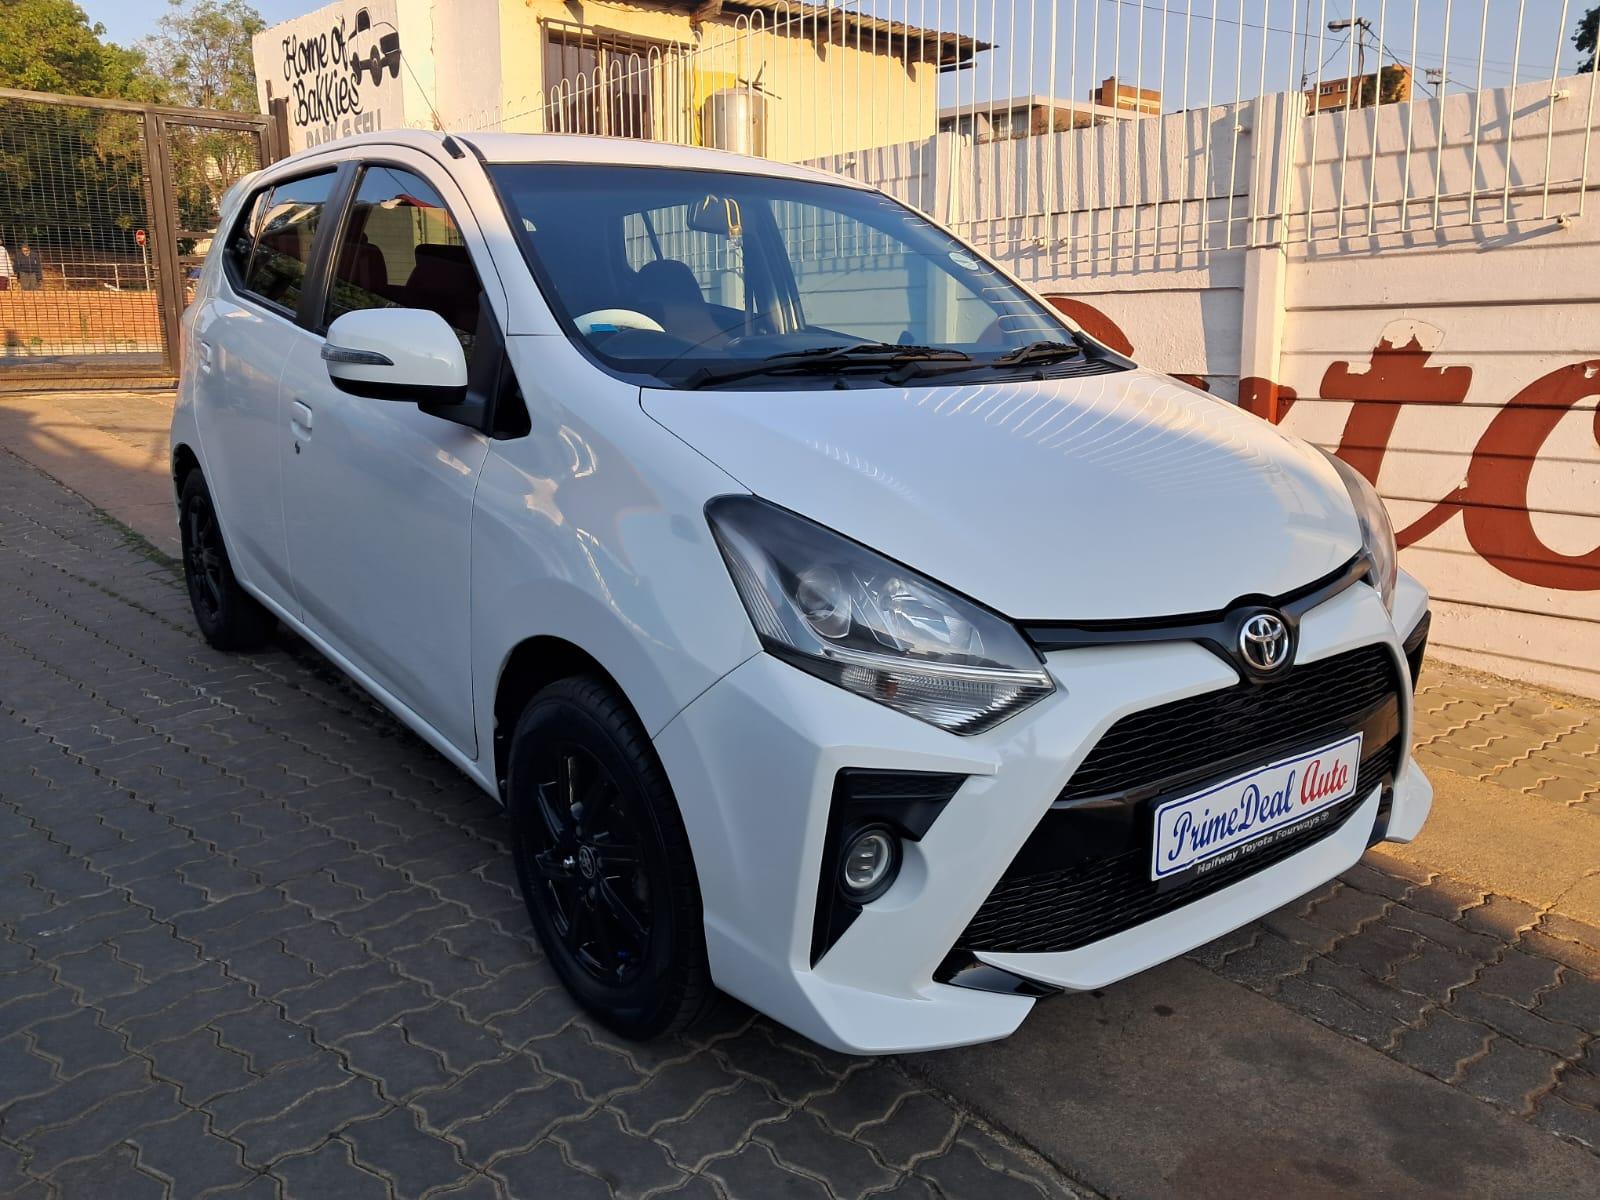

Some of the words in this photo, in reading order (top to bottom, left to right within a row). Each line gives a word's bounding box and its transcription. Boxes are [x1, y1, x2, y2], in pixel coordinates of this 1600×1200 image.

[282, 34, 328, 81] Home
[1300, 759, 1348, 805] Auto
[1197, 851, 1239, 874] Halfway
[1241, 836, 1273, 856] Toyota
[1275, 816, 1321, 840] Fourways
